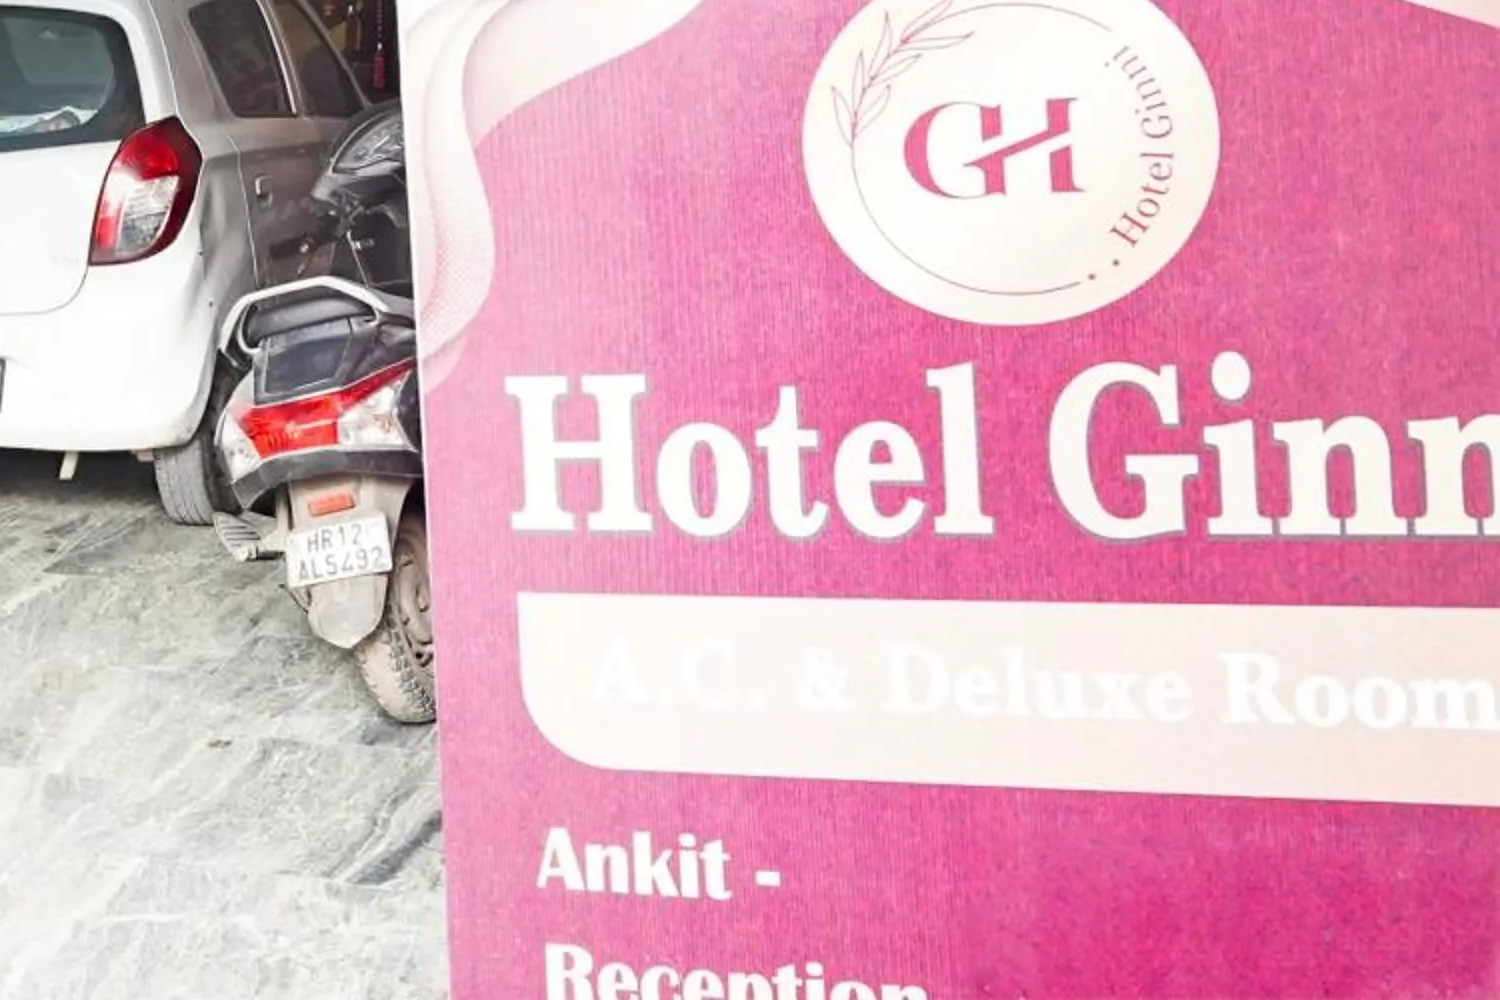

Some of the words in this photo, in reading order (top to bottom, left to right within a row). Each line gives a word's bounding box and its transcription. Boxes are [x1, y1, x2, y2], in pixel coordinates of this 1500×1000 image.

[1103, 44, 1175, 141] Ginni
[903, 96, 1087, 200] GH
[1109, 150, 1175, 248] Hotel
[503, 361, 996, 541] Hotel
[1048, 350, 1500, 542] Ginn
[306, 522, 362, 553] HR12
[587, 633, 766, 708] A.C.
[794, 644, 858, 716] &
[881, 641, 1195, 726] Deluxe
[1218, 651, 1500, 733] Room
[536, 826, 733, 901] Ankit
[544, 941, 929, 1000] Receti
